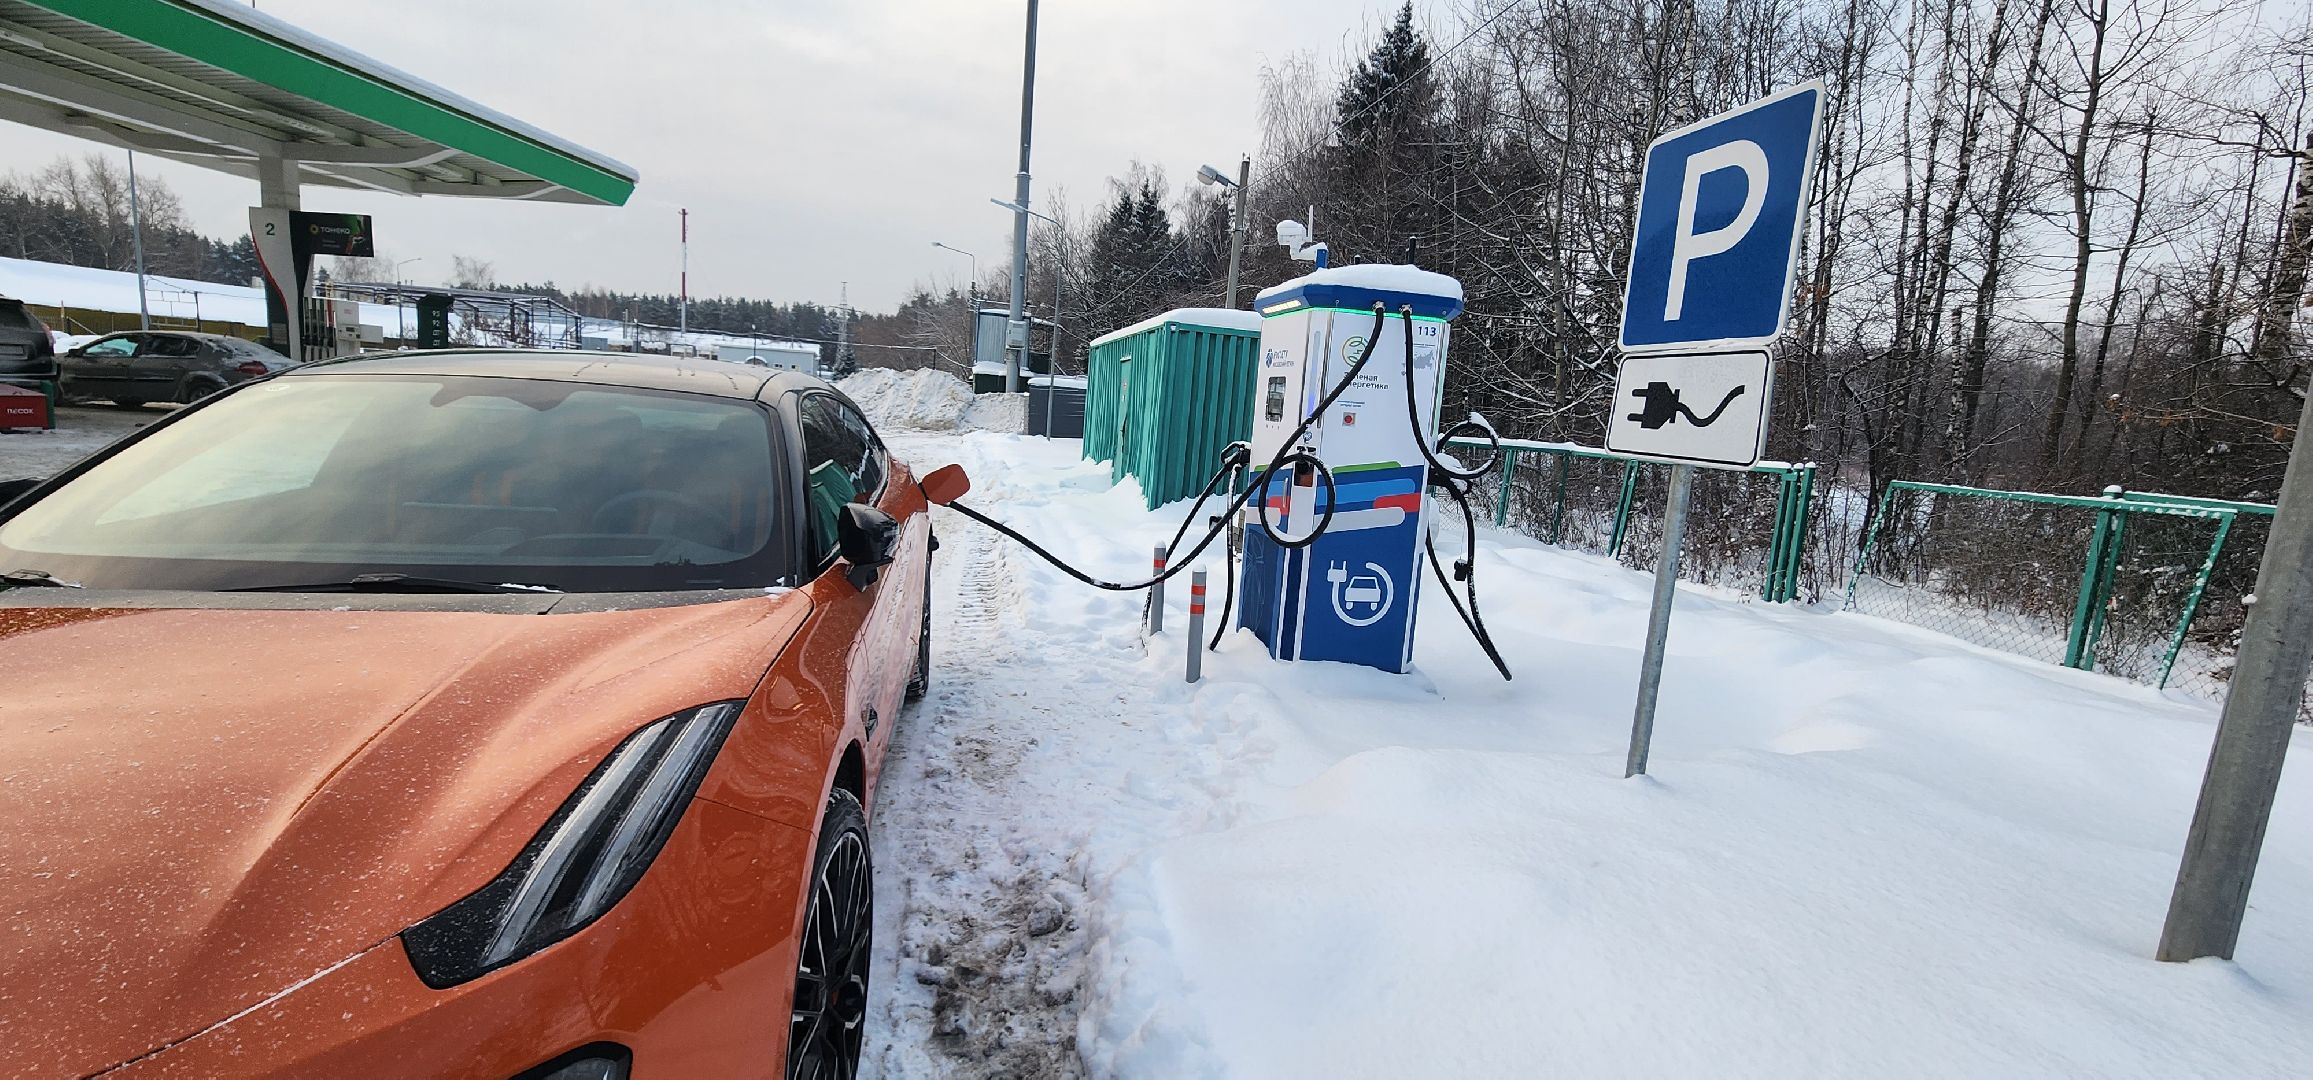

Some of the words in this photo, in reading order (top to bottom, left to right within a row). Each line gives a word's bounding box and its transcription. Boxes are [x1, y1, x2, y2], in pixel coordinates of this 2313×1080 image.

[265, 223, 275, 235] 2
[1664, 139, 1769, 322] P
[1418, 326, 1437, 336] 113
